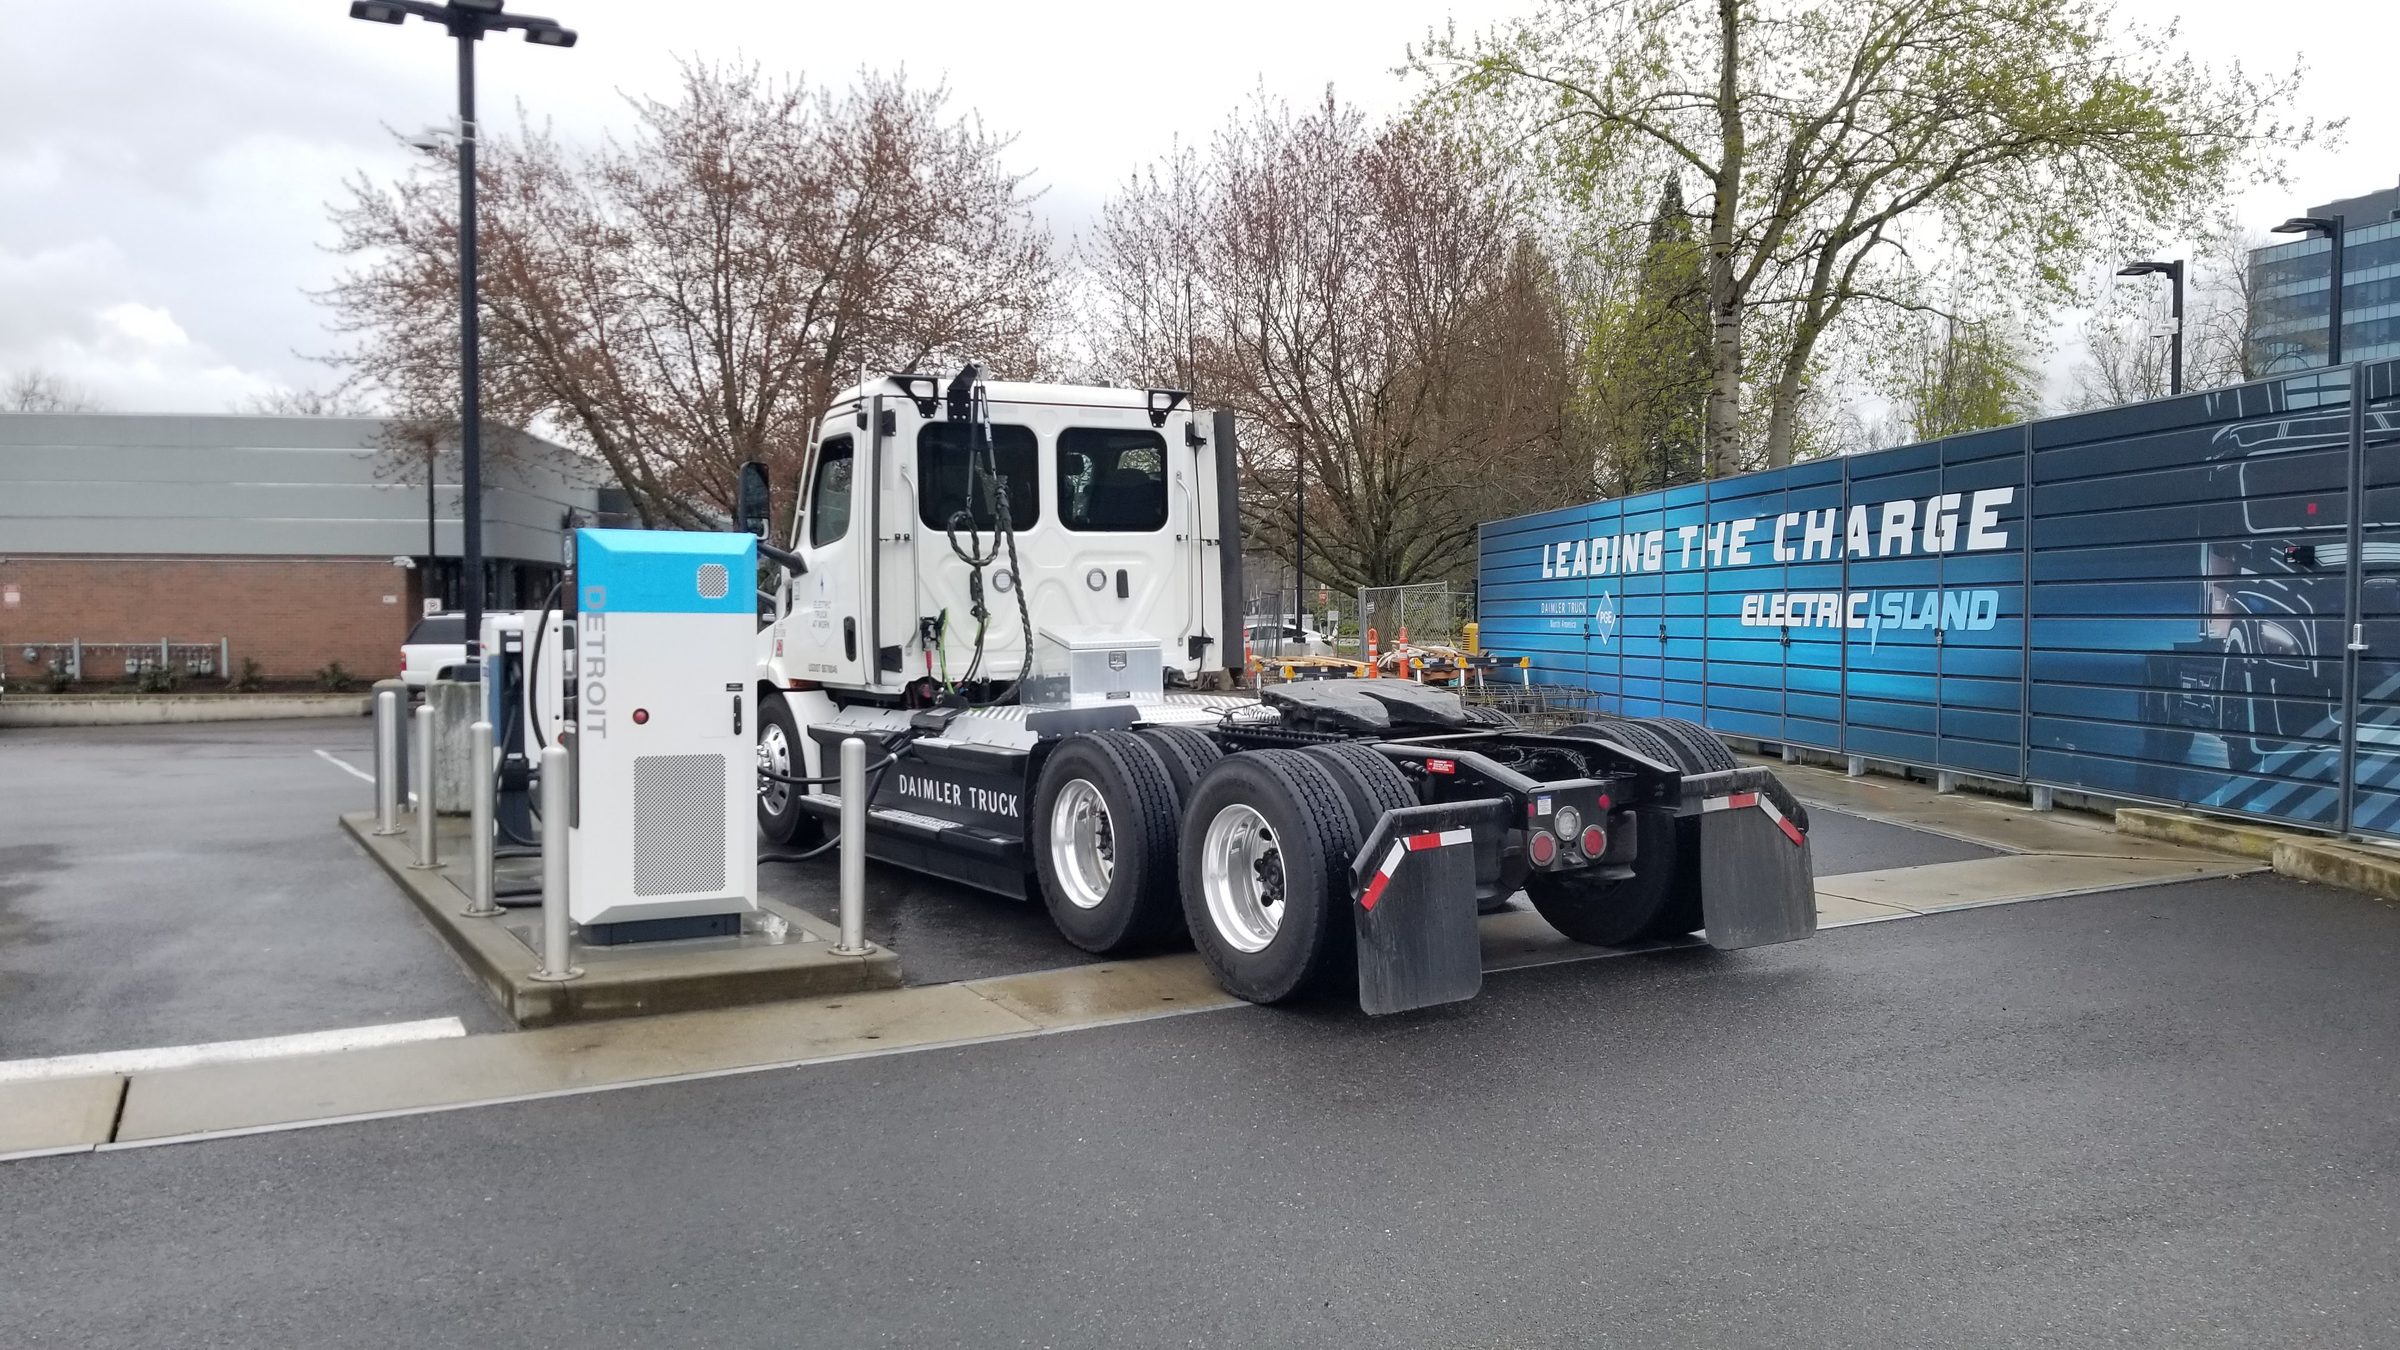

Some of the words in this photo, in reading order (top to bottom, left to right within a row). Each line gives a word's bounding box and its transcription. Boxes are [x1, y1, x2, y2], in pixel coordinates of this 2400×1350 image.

[1542, 530, 1663, 578] LEADING
[1679, 518, 1756, 568] THE
[1773, 487, 2014, 562] CHARGE
[1541, 602, 1565, 614] DAIMLER
[1568, 601, 1587, 614] TRUCK
[1600, 611, 1612, 624] PGE
[1741, 592, 1868, 628] ELECTRIC
[585, 586, 607, 739] DETROIT
[899, 774, 961, 806] DAIMLER
[968, 786, 1018, 818] TRUCK
